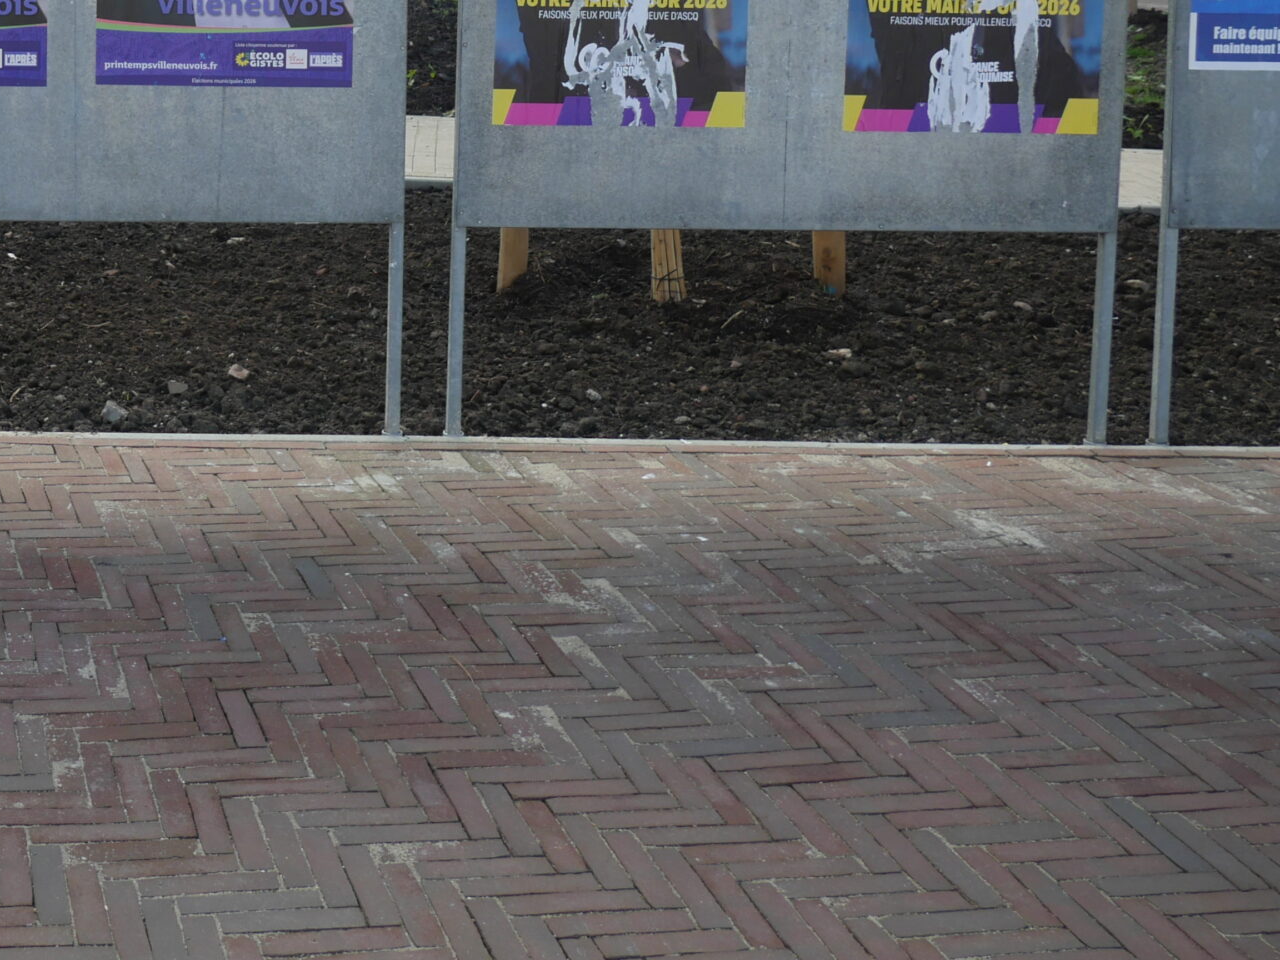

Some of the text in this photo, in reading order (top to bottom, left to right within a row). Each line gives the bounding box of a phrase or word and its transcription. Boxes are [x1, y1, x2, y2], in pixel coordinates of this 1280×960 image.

[538, 10, 571, 20] FAISONS
[599, 10, 620, 20] POUR
[670, 11, 699, 21] D'ASCQ
[890, 16, 924, 26] FAISONS
[924, 16, 950, 26] MIEUX
[951, 17, 975, 26] POUR
[1213, 25, 1247, 40] Faire
[1212, 42, 1276, 54] maintenant
[249, 49, 284, 60] ÉCOLO
[103, 60, 218, 73] printempsvilleneuvois.fr
[249, 60, 284, 68] GISTES
